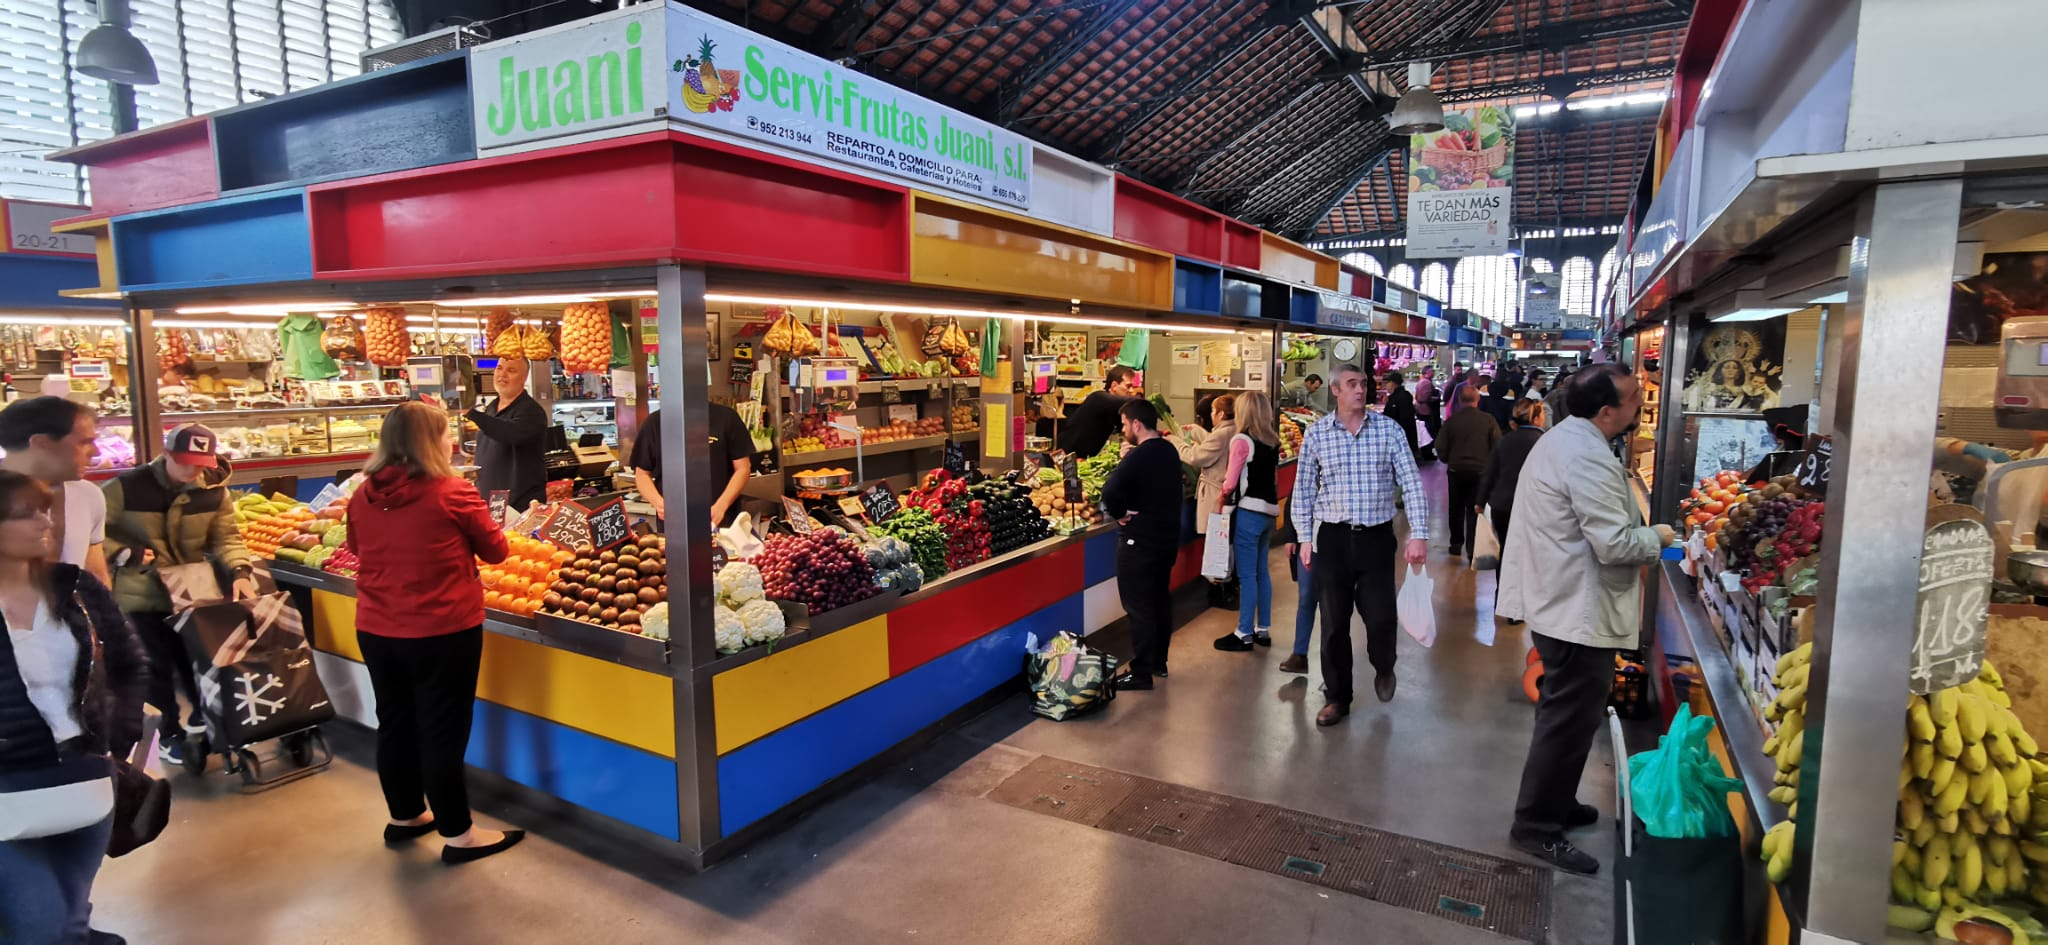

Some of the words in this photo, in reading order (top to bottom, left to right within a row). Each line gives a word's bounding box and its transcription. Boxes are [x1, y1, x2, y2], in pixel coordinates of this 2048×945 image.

[487, 20, 644, 136] Juani
[744, 44, 929, 151] Servi-Frutas
[934, 114, 999, 179] Juani,
[1003, 142, 1027, 182] s.l.
[760, 121, 777, 136] 952
[779, 126, 795, 141] 213
[796, 131, 812, 145] 944
[827, 131, 886, 156] REPARTO
[888, 149, 896, 160] A
[898, 151, 954, 175] DOMICILIO
[827, 141, 898, 170] Restaurantes,
[946, 175, 951, 184] y
[953, 175, 982, 192] Hoteles
[1417, 200, 1431, 212] TE
[1435, 198, 1466, 211] DAN
[1470, 193, 1500, 209] MÁS
[1425, 209, 1491, 223] VARIEDAD
[16, 233, 69, 250] 20-21
